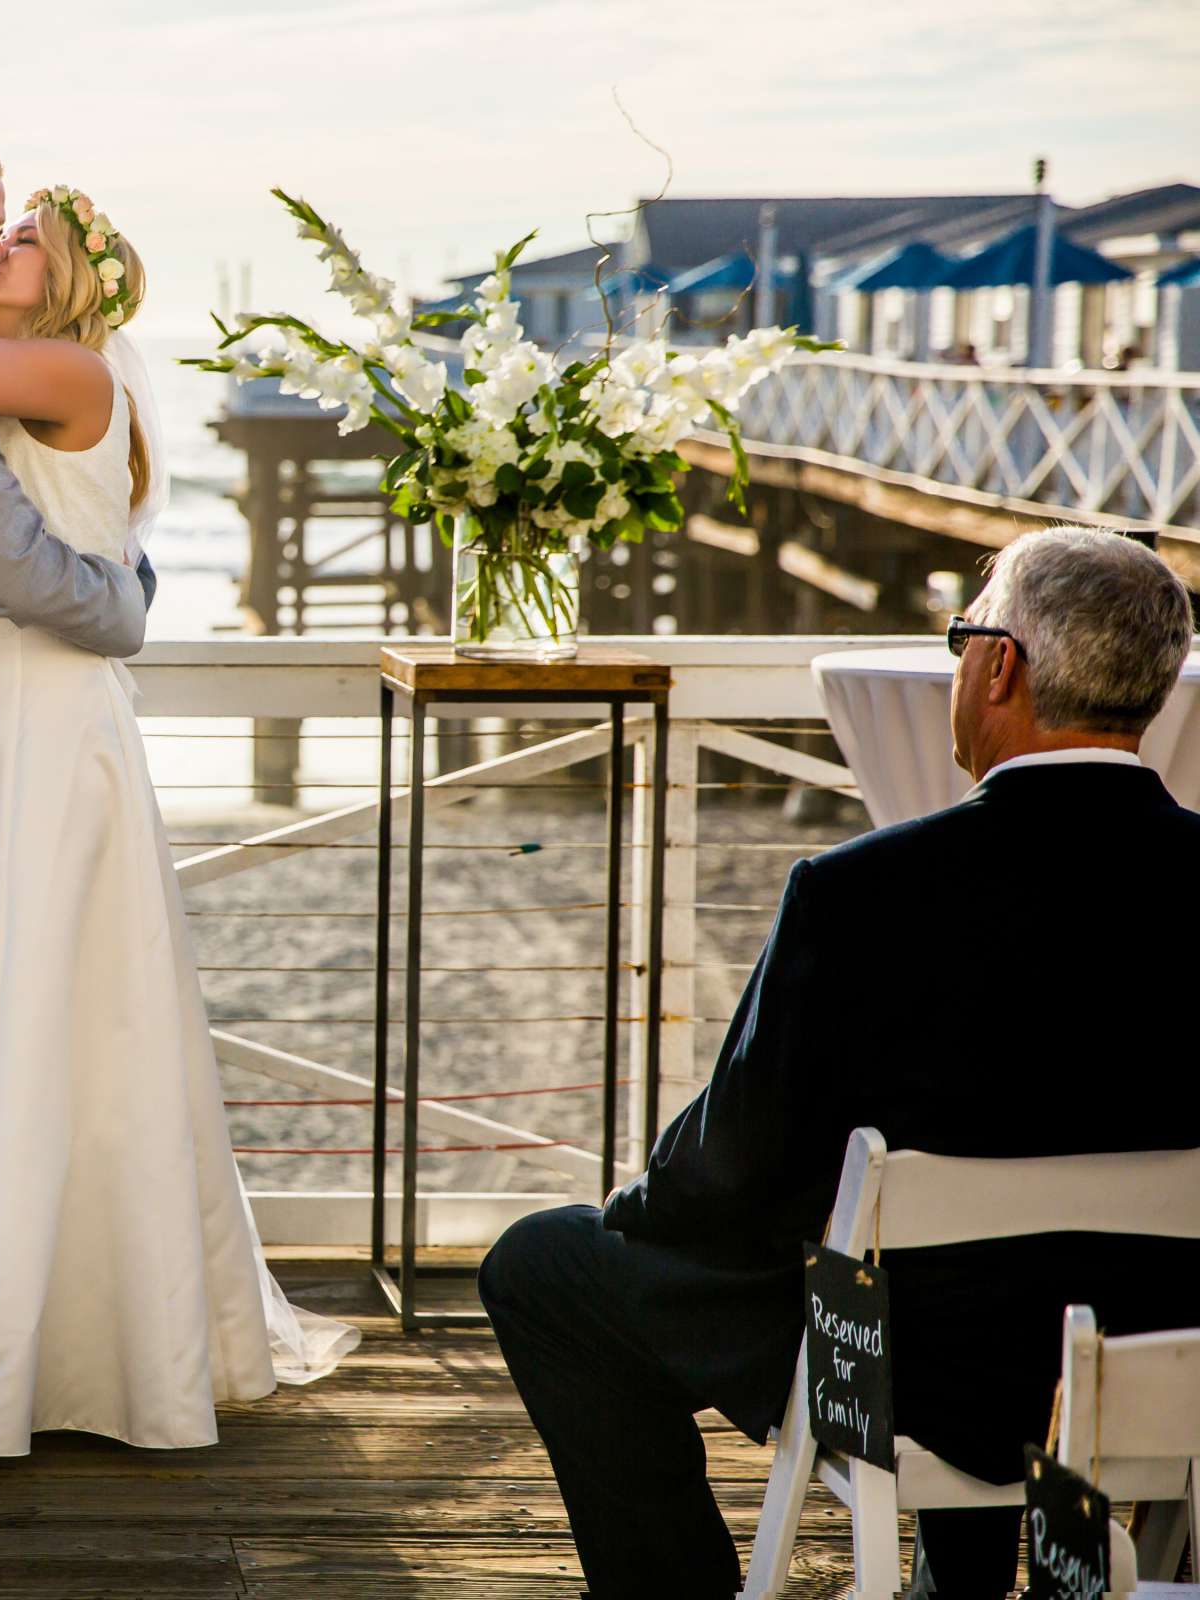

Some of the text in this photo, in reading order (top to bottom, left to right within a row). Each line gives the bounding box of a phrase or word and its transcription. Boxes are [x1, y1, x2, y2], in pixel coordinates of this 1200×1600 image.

[811, 1291, 883, 1357] Reserved
[833, 1346, 856, 1382] for
[815, 1377, 869, 1455] Family
